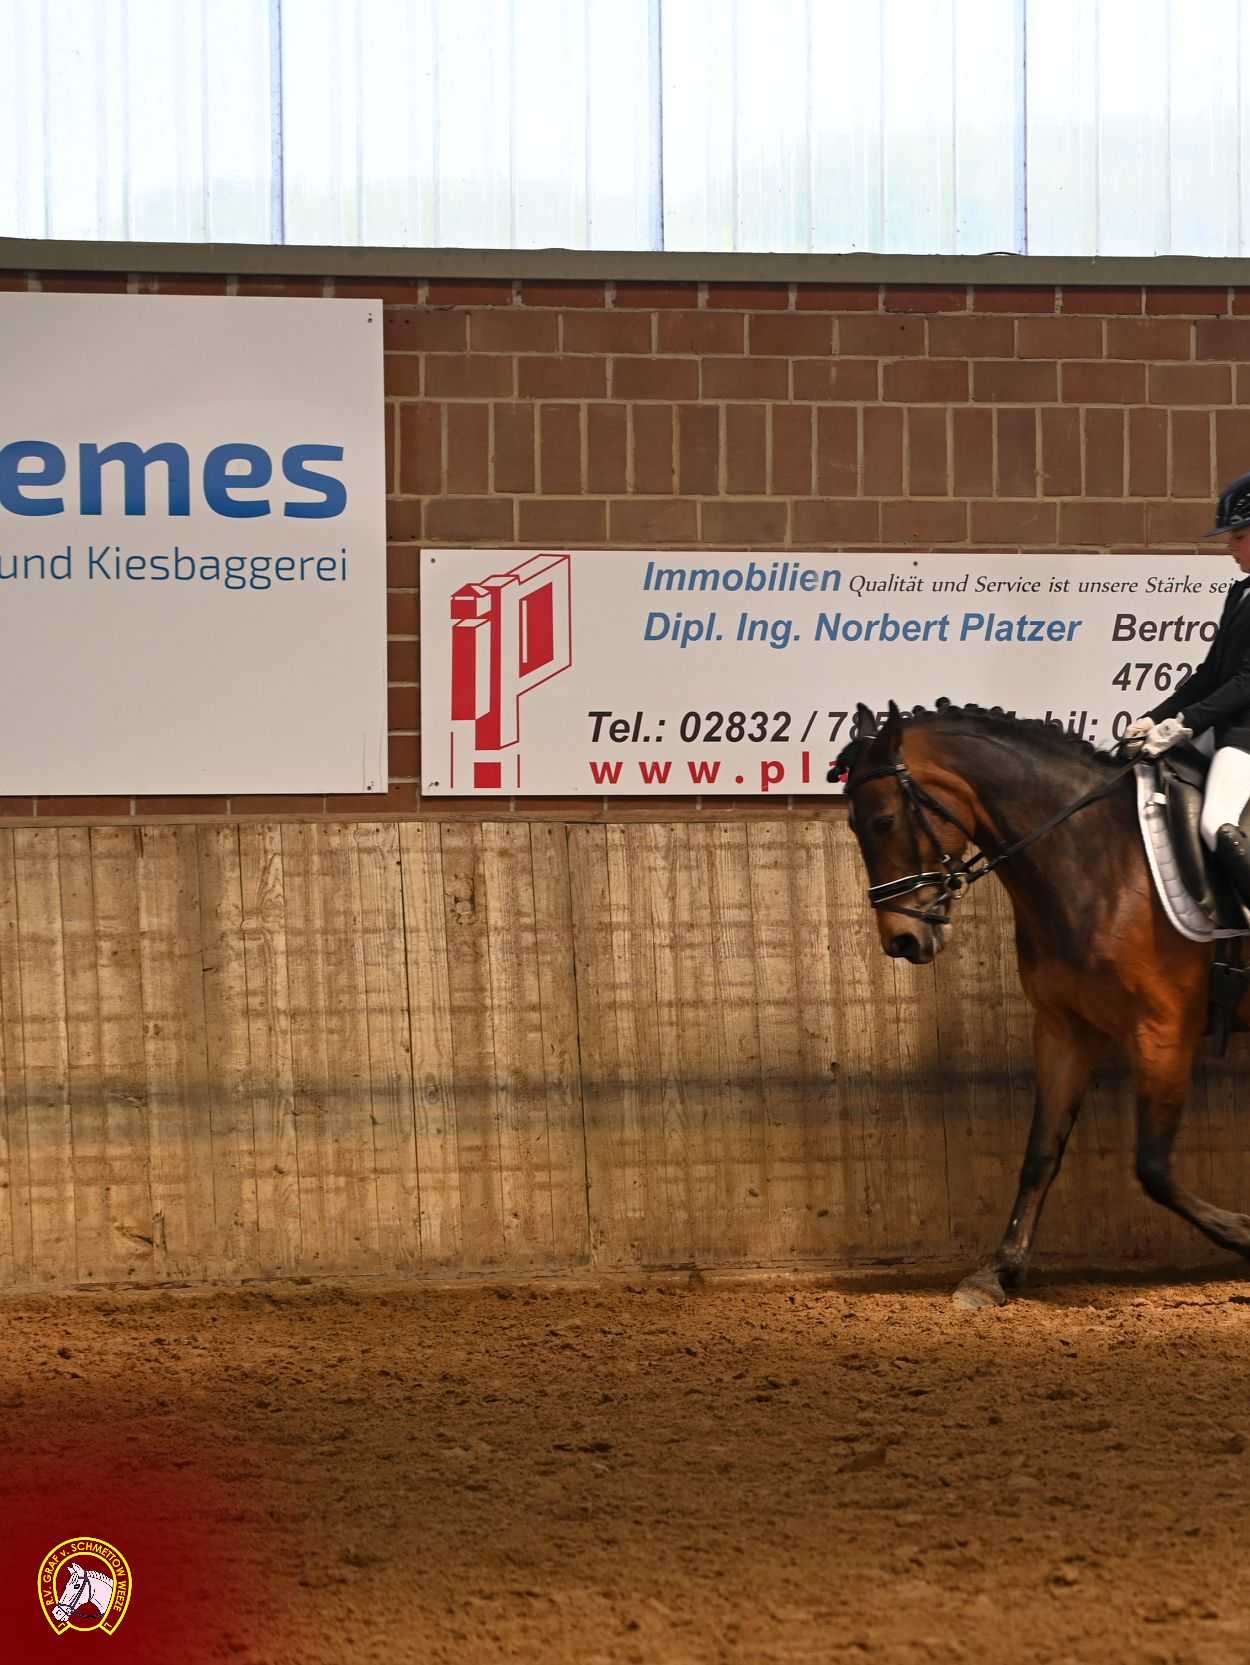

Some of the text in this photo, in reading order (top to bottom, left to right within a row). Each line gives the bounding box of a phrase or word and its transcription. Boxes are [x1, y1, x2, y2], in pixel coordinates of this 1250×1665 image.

[0, 441, 347, 519] emes
[0, 546, 345, 589] und Kiesbaggerei
[644, 562, 841, 591] Immobilien
[850, 574, 924, 597] Qualität
[933, 574, 969, 592] und
[975, 576, 1040, 592] Service
[1049, 577, 1070, 592] ist
[1079, 582, 1138, 592] unsere
[1145, 575, 1202, 593] Stärke
[1209, 577, 1234, 593] sei
[644, 612, 722, 648] Dipl.
[737, 613, 800, 649] Ing.
[815, 613, 949, 641] Norbert
[960, 613, 1082, 641] Platzer
[1112, 663, 1193, 691] 4762
[588, 712, 665, 743] Tel.:
[680, 711, 791, 742] 02832
